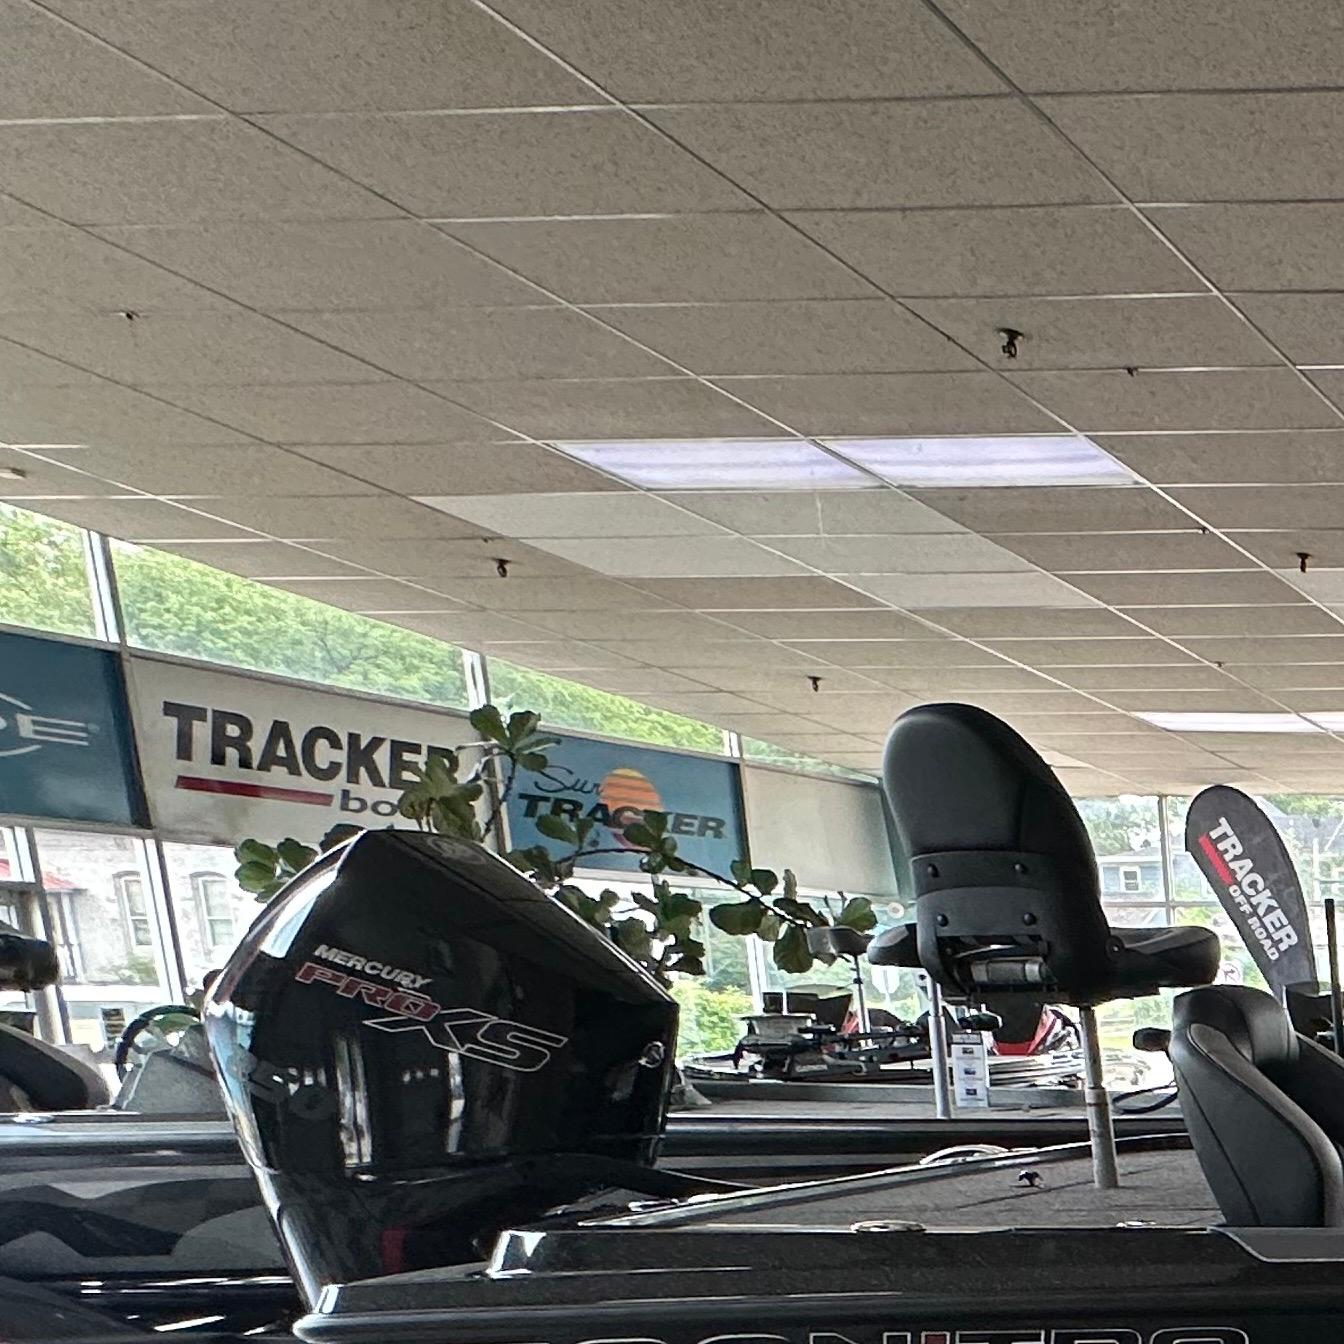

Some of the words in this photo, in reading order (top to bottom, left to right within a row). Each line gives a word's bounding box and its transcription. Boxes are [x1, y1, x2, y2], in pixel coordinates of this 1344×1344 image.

[1208, 816, 1299, 952] TRACKER
[1228, 884, 1251, 915] OFF
[1247, 917, 1280, 961] ROAD
[295, 962, 441, 1021] PRO
[312, 943, 433, 988] MERCURY
[362, 1007, 569, 1072] XS
